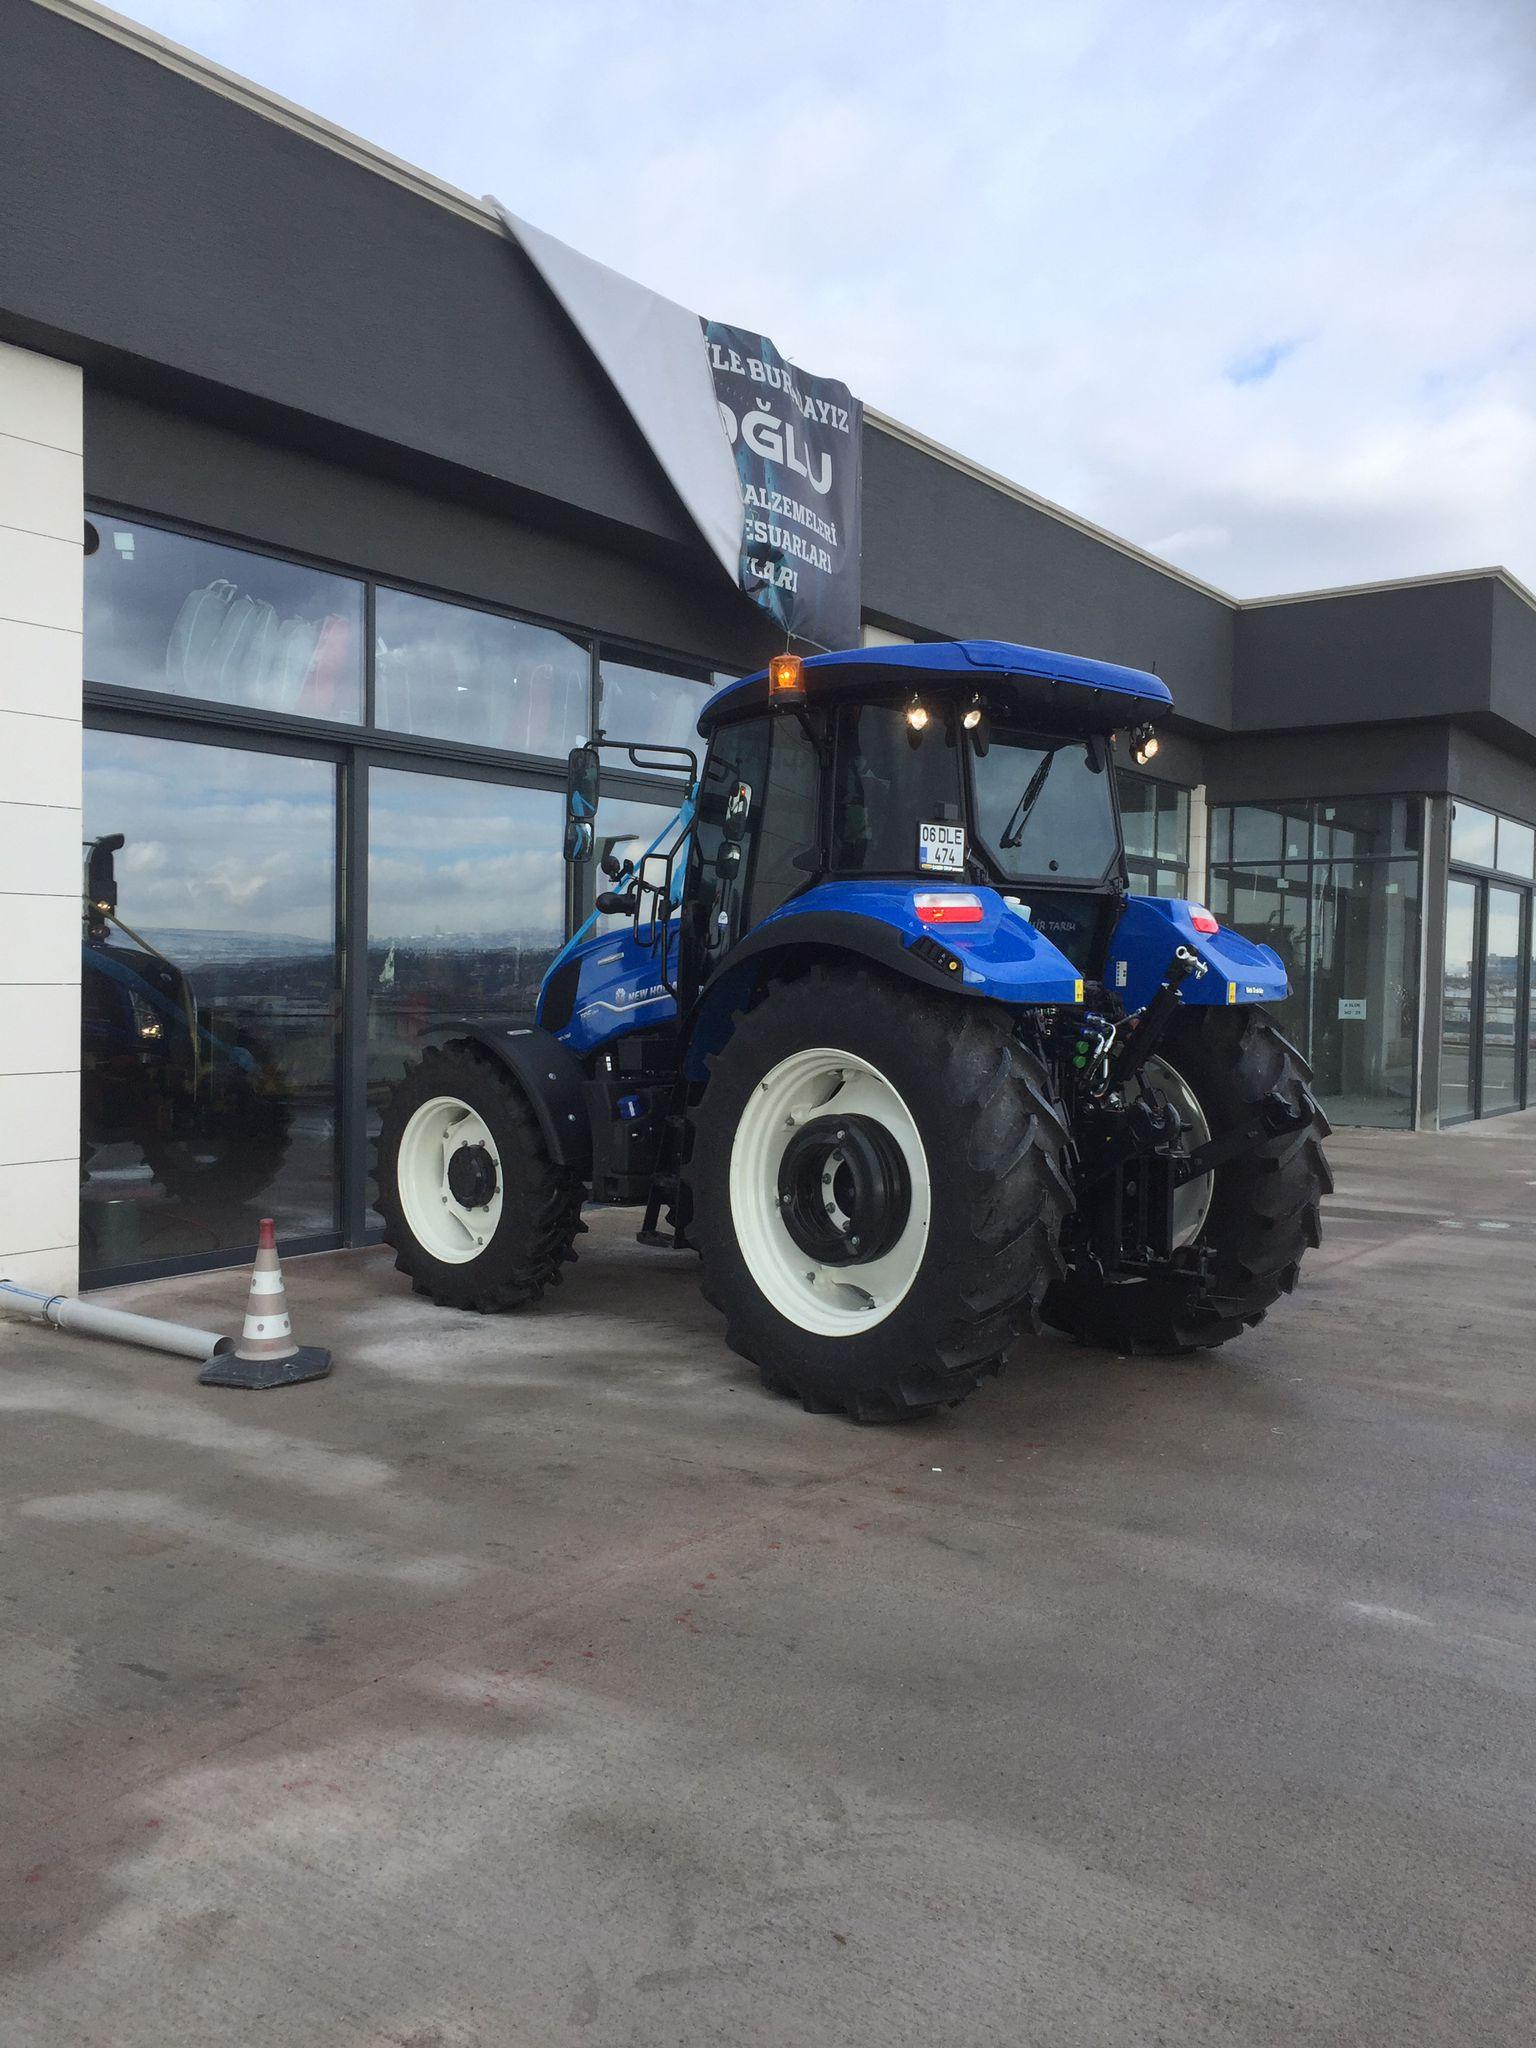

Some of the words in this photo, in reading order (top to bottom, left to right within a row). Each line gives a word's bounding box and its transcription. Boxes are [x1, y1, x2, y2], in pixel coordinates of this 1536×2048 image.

[742, 483, 838, 547] ALZEMELERİ
[746, 556, 799, 594] LARI
[922, 826, 936, 842] 06
[938, 827, 962, 845] DLE
[935, 848, 955, 864] 474
[628, 988, 649, 1001] NEW
